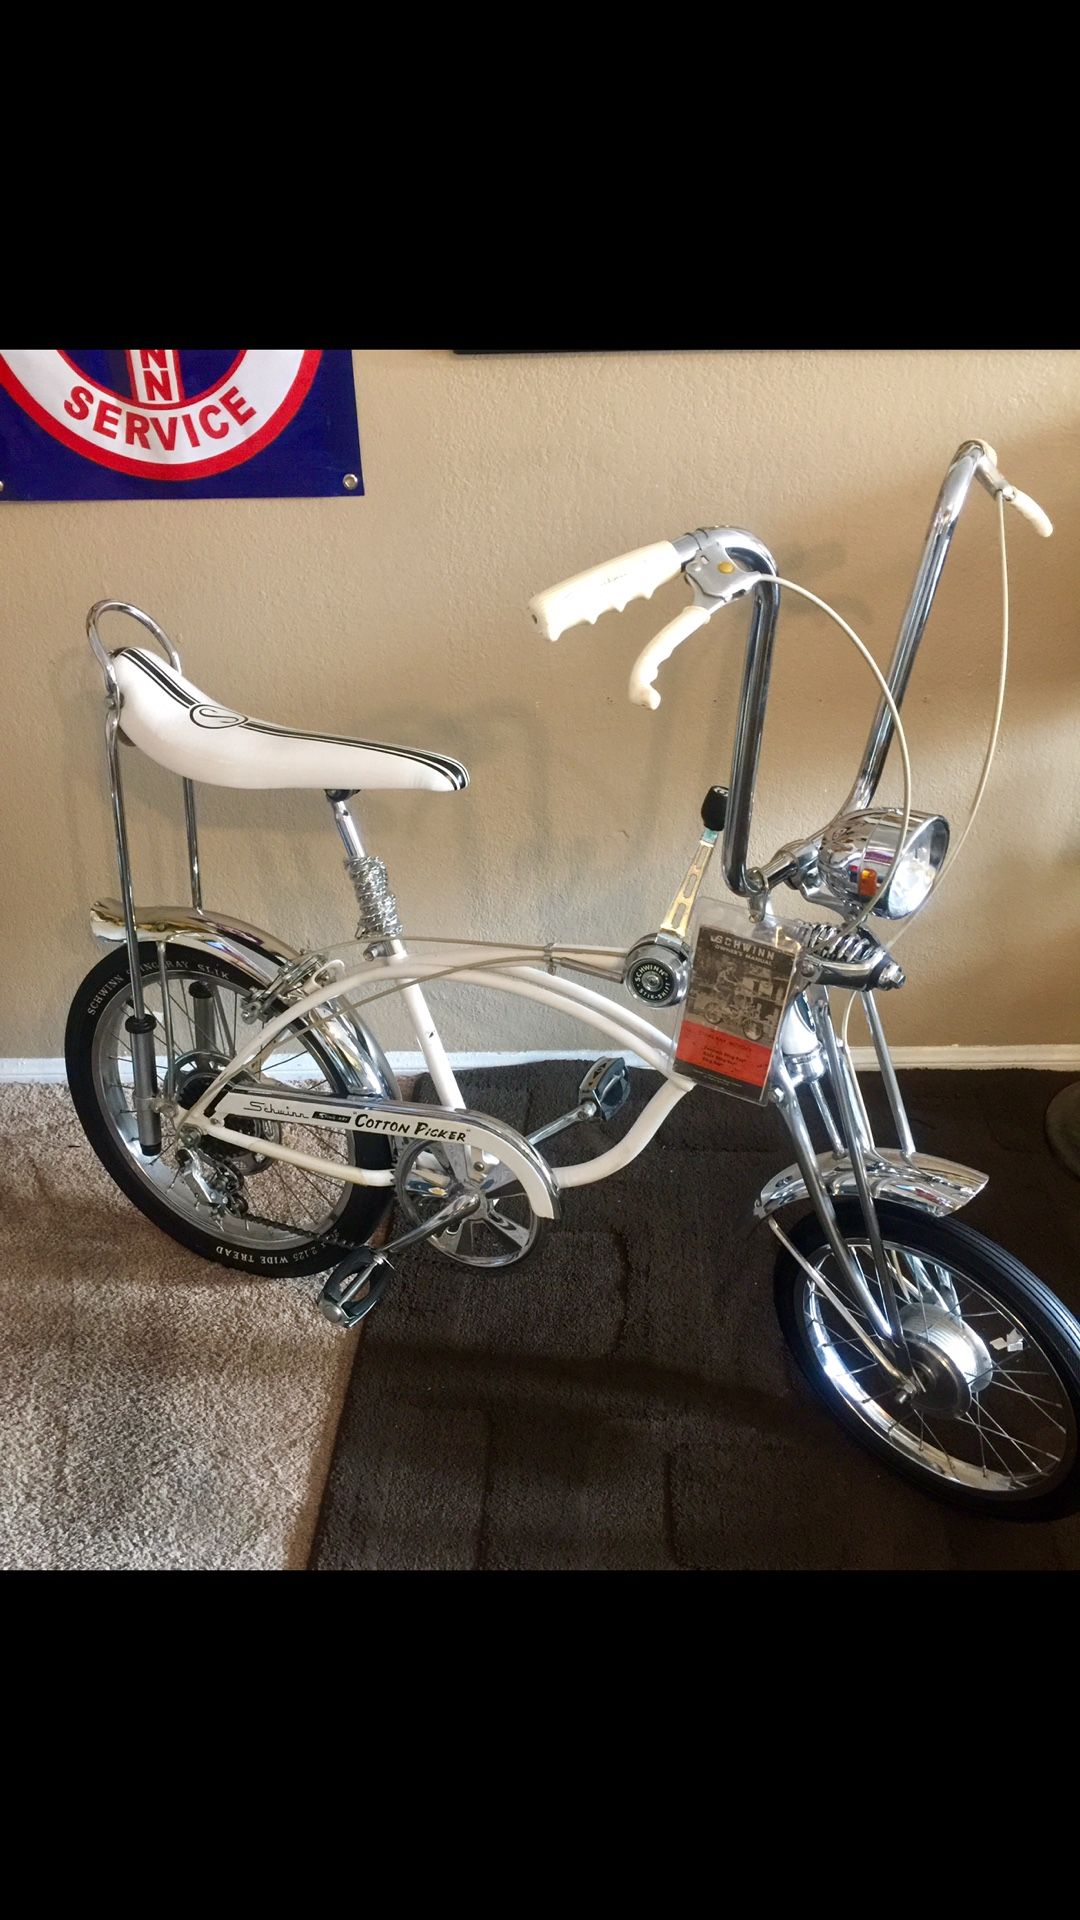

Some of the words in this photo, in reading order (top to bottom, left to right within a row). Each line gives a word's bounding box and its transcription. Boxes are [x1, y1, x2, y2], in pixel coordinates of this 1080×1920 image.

[64, 386, 256, 451] SERVICE
[710, 935, 775, 961] SCHWINN
[745, 953, 773, 966] MANUAL
[634, 964, 666, 982] SCHWINN
[87, 974, 125, 1016] SCHWINN
[197, 963, 231, 980] SLIK
[243, 1101, 310, 1119] Schwinn
[216, 1245, 255, 1264] TREAD
[260, 1255, 289, 1265] WIDE
[292, 1246, 319, 1262] 2.125
